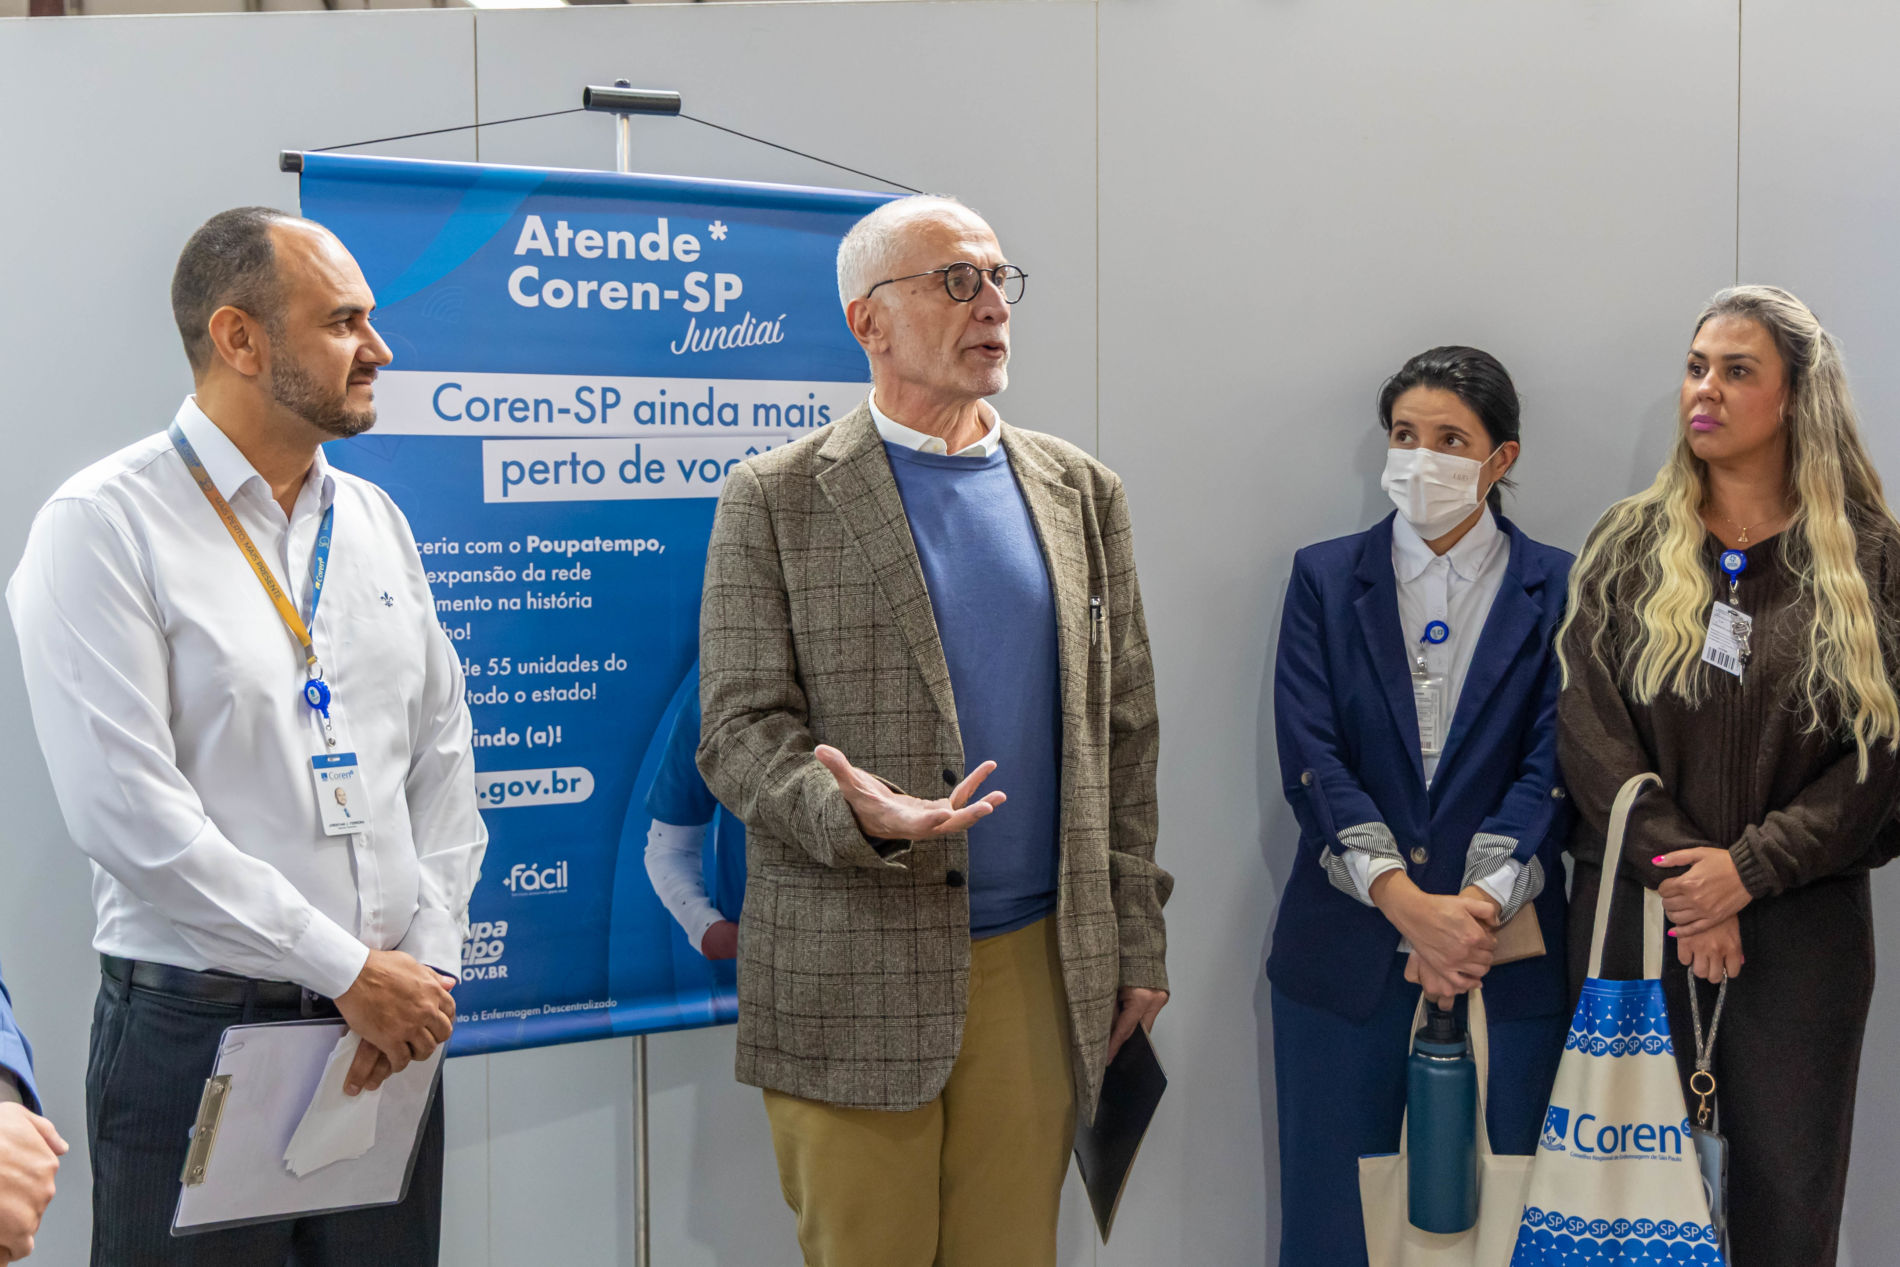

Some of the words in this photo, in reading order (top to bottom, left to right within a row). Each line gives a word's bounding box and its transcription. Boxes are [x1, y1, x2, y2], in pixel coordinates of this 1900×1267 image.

[507, 265, 743, 313] Coren-SP
[670, 311, 787, 355] Jundiaí
[432, 382, 621, 424] Coren-SP
[633, 386, 739, 426] ainda
[753, 392, 831, 428] mais
[501, 451, 605, 498] perto
[619, 443, 666, 484] de
[465, 541, 503, 554] com
[509, 541, 521, 553] o
[526, 535, 666, 558] Poupatempo,
[426, 566, 517, 589] expansão
[522, 562, 546, 581] da
[551, 561, 592, 581] rede
[432, 595, 493, 612] mento
[498, 598, 521, 610] na
[526, 590, 593, 610] história
[487, 657, 511, 676] 55
[518, 653, 599, 675] unidades
[604, 652, 628, 671] do
[467, 685, 509, 705] todo
[514, 691, 526, 703] o
[531, 681, 597, 702] estado!
[526, 725, 562, 748] (a)!
[481, 1007, 541, 1020] Enfermagem
[543, 998, 618, 1015] Descentralizado
[1580, 1037, 1589, 1050] SP
[1590, 1040, 1606, 1053] SP
[1612, 1042, 1625, 1054] SP
[1628, 1039, 1640, 1052] SP
[1645, 1039, 1661, 1051] SP
[1573, 1113, 1682, 1154] Coren
[1528, 1211, 1543, 1222] SP
[1550, 1215, 1563, 1227] SP
[1568, 1220, 1585, 1232] SP
[1591, 1223, 1608, 1235] SP
[1614, 1222, 1630, 1234] SP
[1636, 1223, 1653, 1234] SP
[1660, 1224, 1676, 1236] SP
[1682, 1226, 1699, 1238] SP
